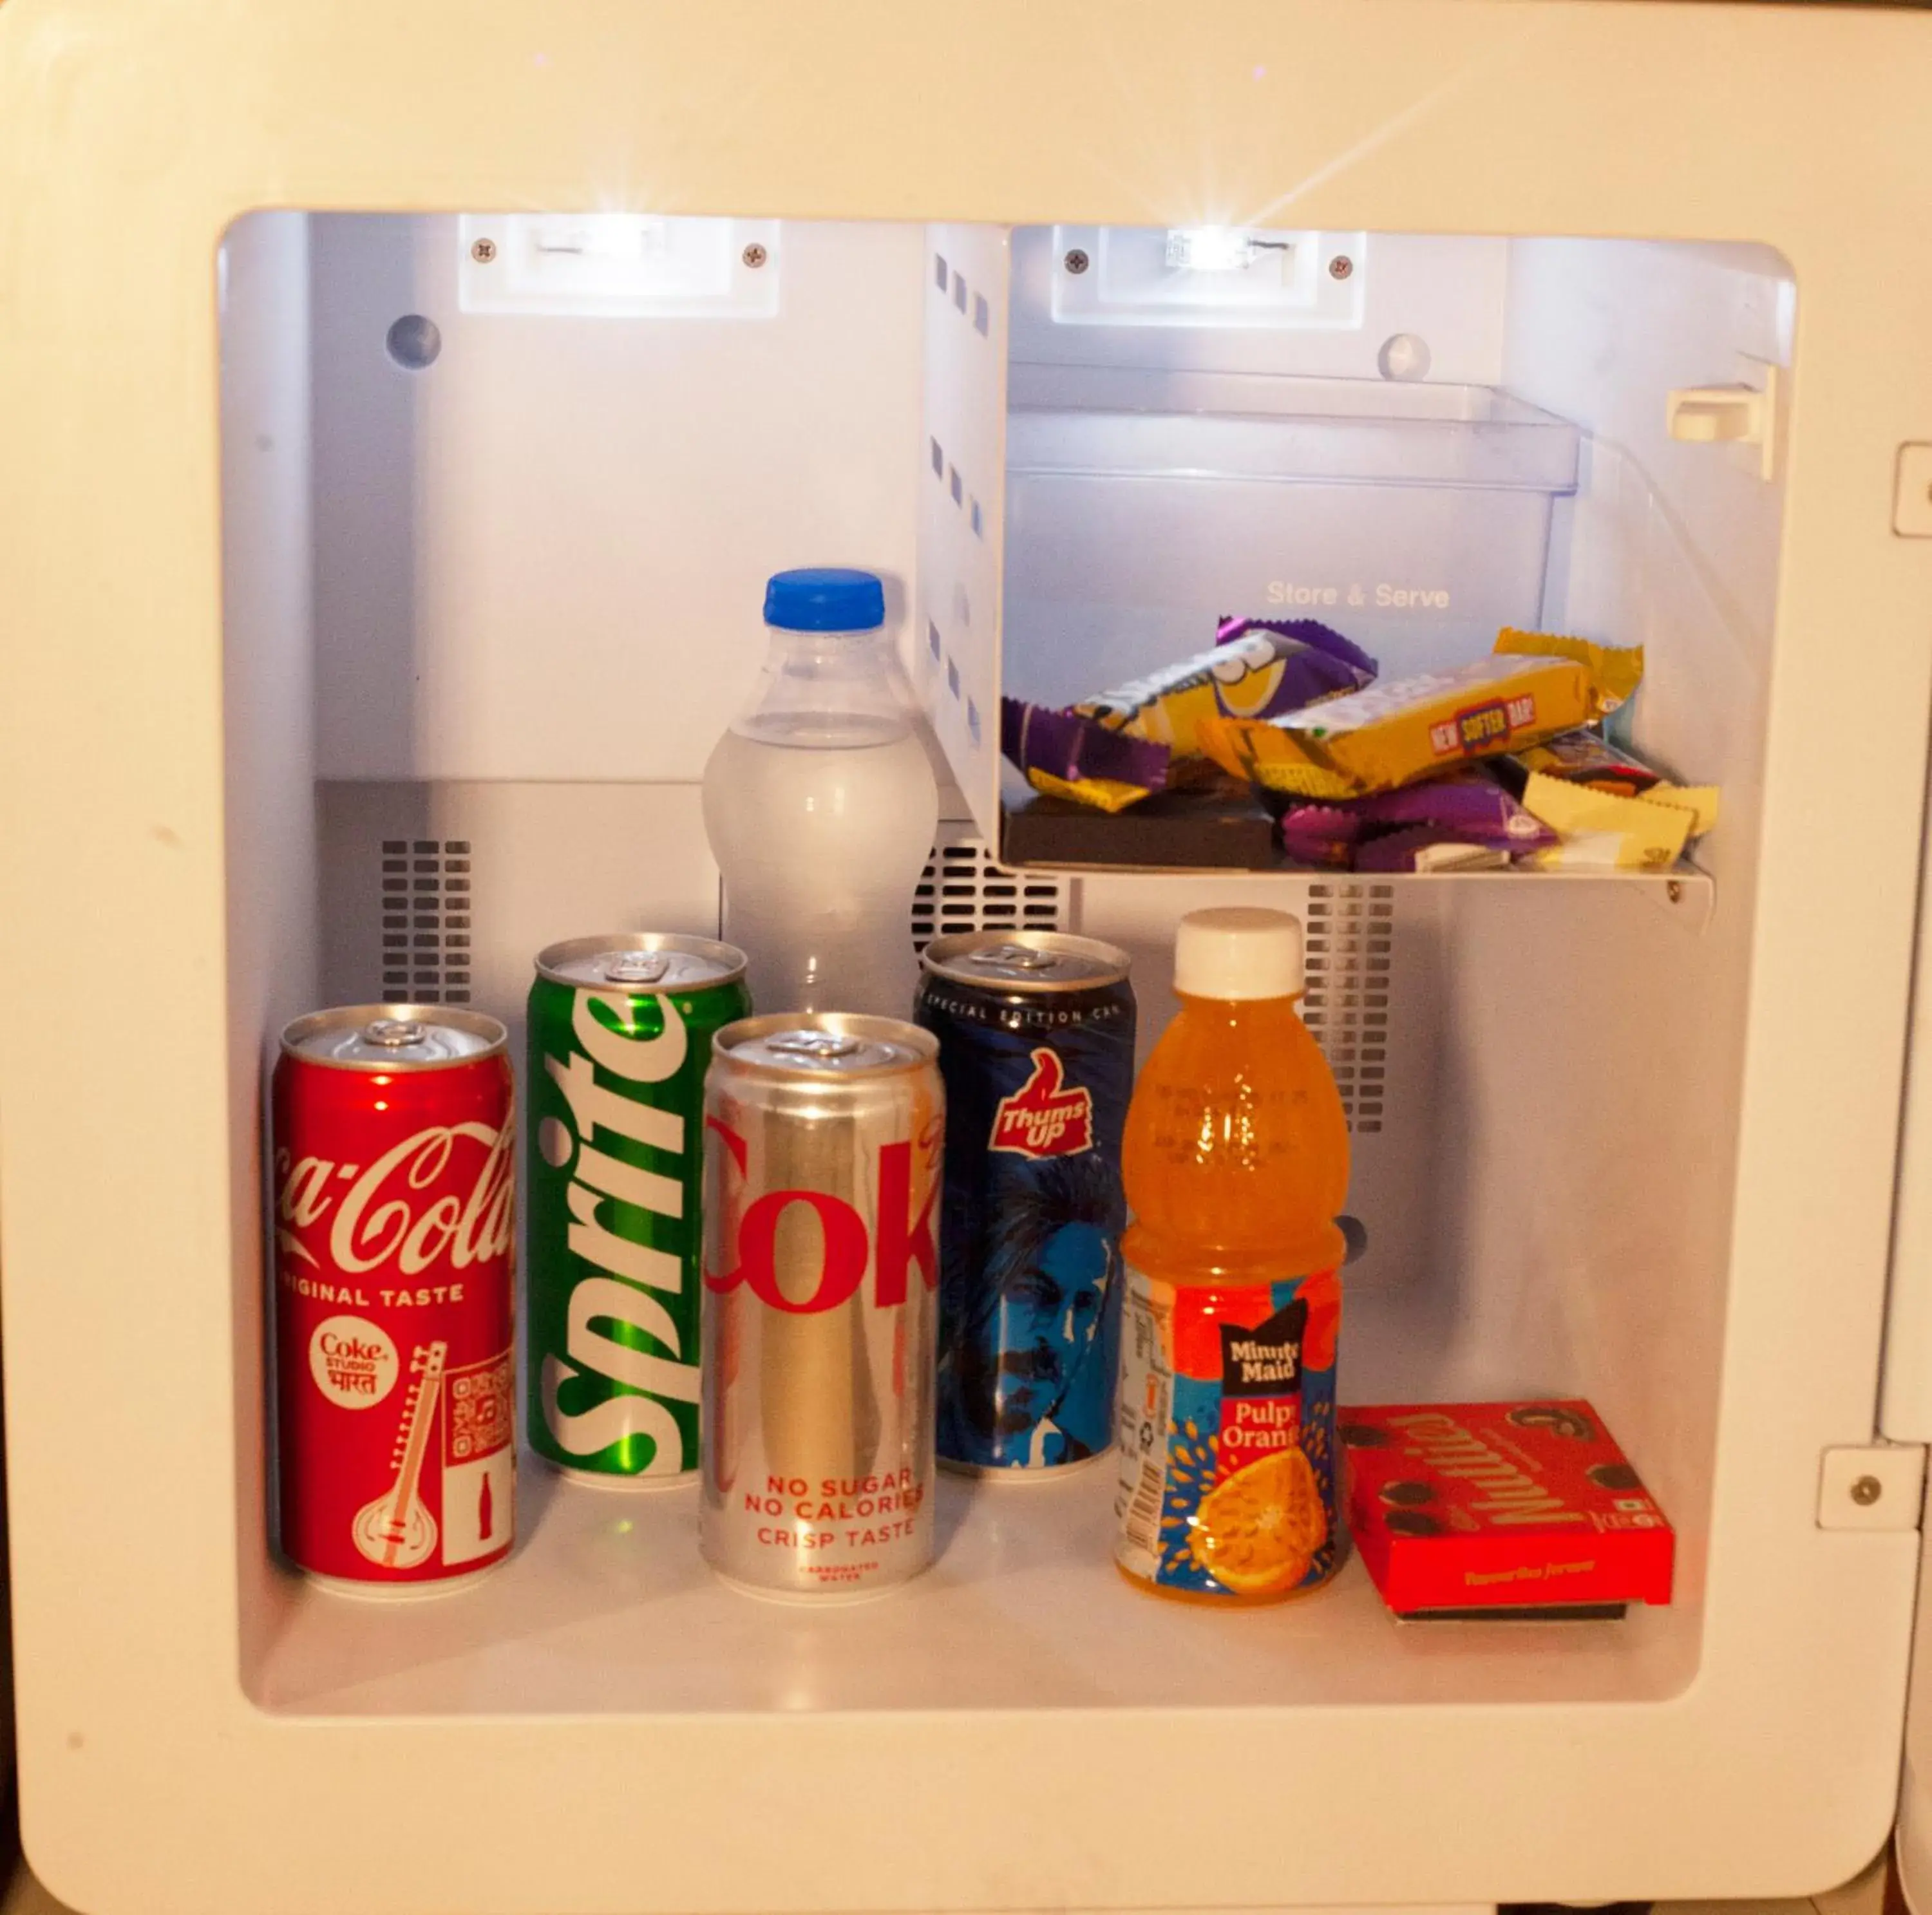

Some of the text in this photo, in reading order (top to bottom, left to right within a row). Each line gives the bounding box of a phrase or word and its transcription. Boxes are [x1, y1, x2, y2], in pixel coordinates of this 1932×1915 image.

[1267, 580, 1450, 608] Store & Serve
[1430, 721, 1459, 753] NEW
[1461, 708, 1506, 742] SOFTER
[999, 1009, 1083, 1024] EDITION
[1003, 1101, 1085, 1133] Thums
[538, 987, 701, 1475] Sprite
[379, 1283, 464, 1308] TASTE
[319, 1331, 389, 1361] Coke
[326, 1356, 376, 1372] STUDIO
[1241, 1359, 1296, 1383] Maid
[327, 1370, 377, 1395] भारत
[766, 1467, 911, 1498] NO SUGAR
[744, 1482, 924, 1521] NO CALORIES
[757, 1517, 916, 1549] CRISP TASTE
